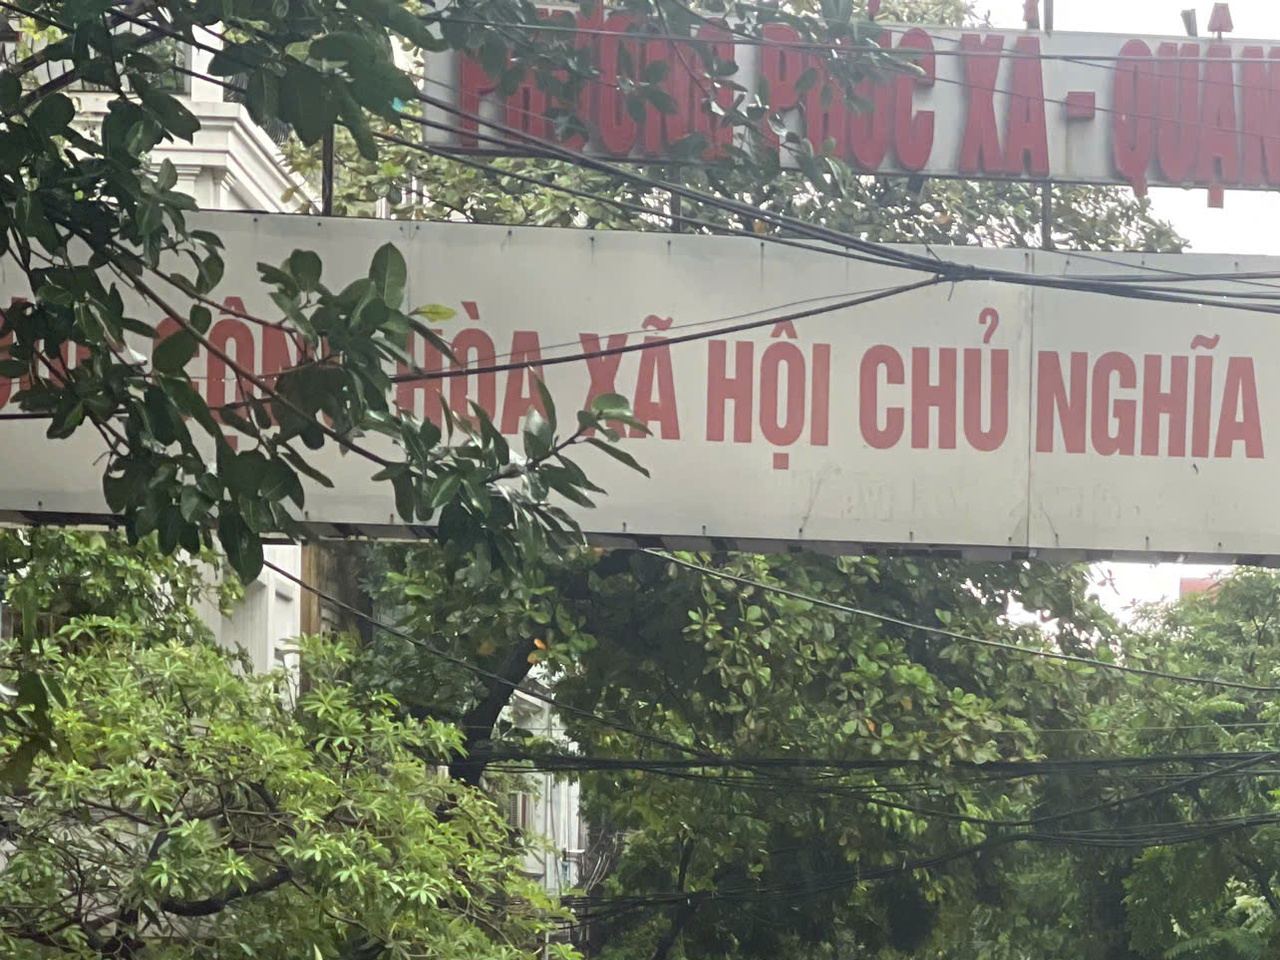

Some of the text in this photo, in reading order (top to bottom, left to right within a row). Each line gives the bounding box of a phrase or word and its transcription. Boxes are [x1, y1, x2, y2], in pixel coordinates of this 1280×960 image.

[394, 301, 557, 437] HÒA
[579, 314, 681, 441] XÃ
[705, 320, 830, 470] HỘI
[858, 307, 1010, 452] CHỦ
[1036, 334, 1265, 459] NGHĨA
